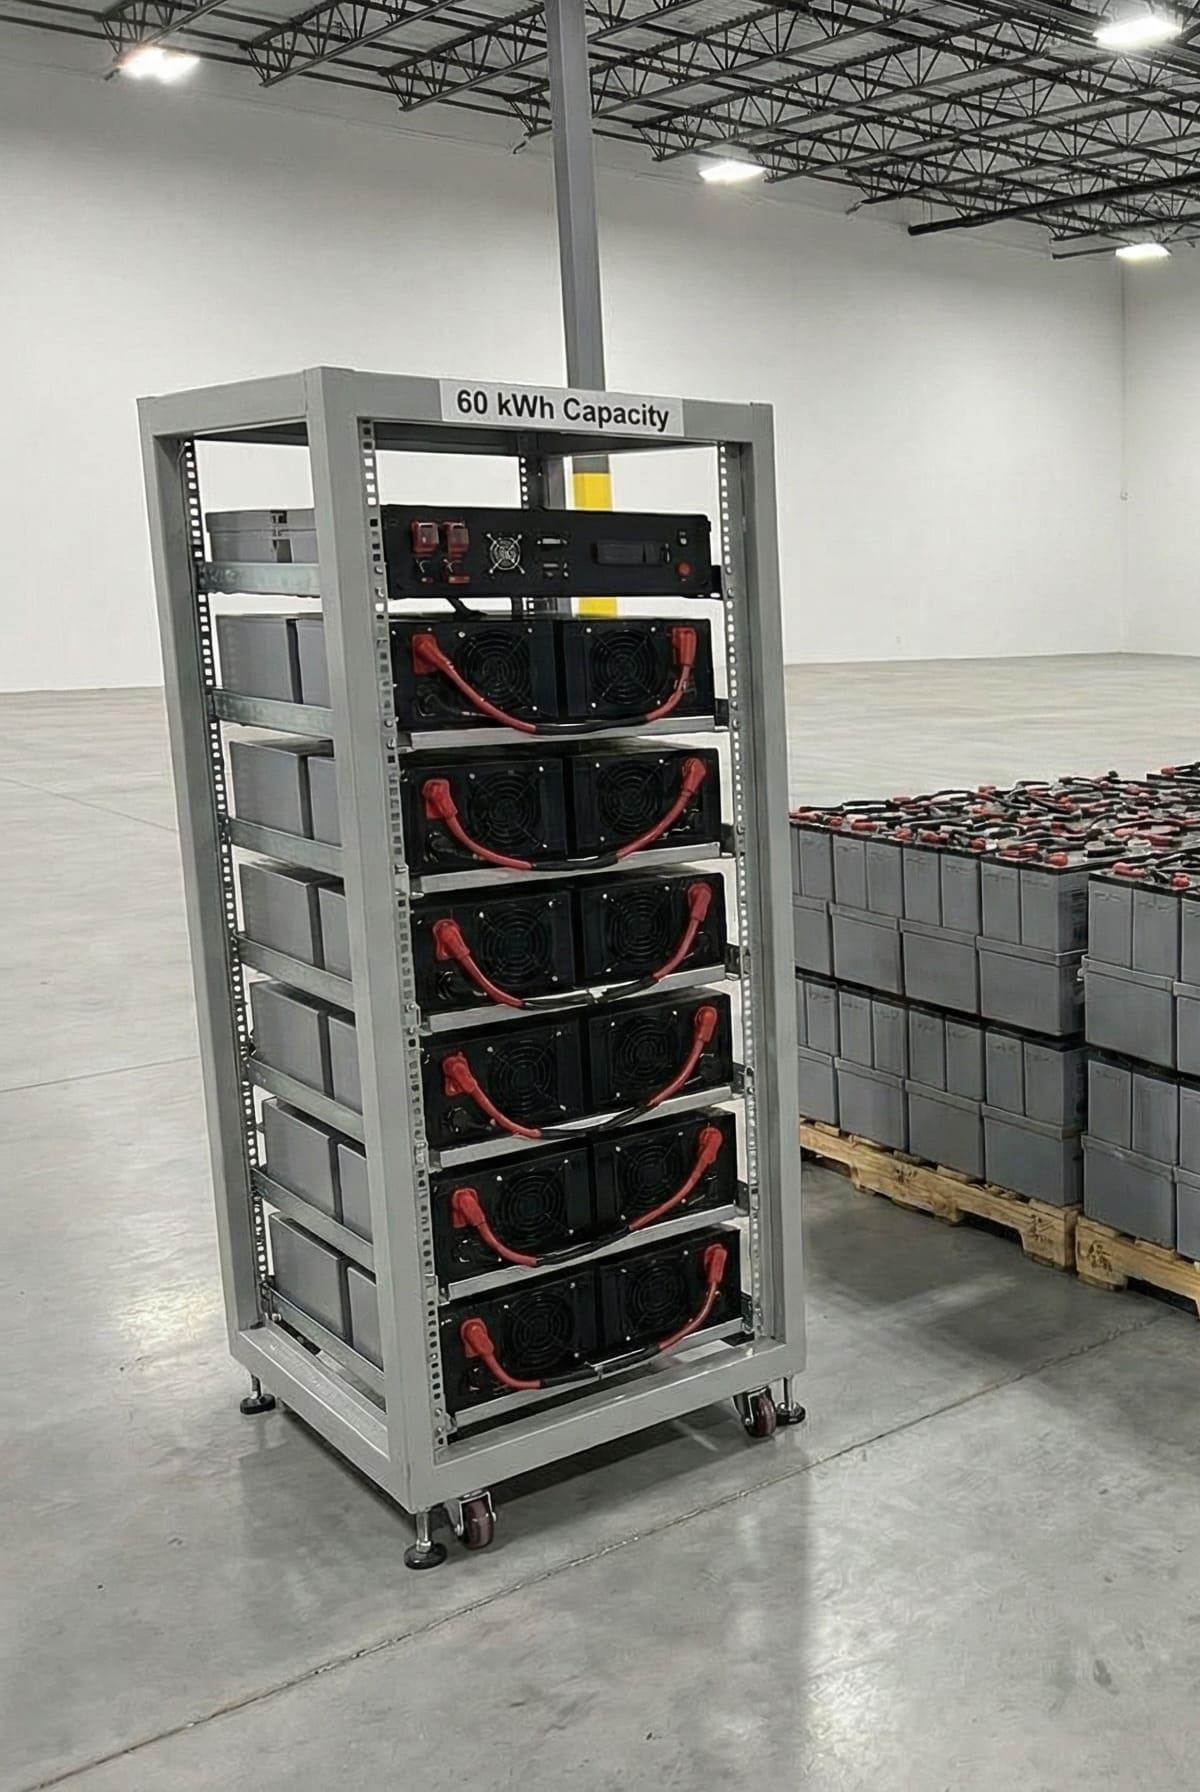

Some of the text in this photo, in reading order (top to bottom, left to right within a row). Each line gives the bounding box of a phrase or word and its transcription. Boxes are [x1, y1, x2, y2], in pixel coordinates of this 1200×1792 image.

[457, 389, 669, 433] 60 kWh Capacity
